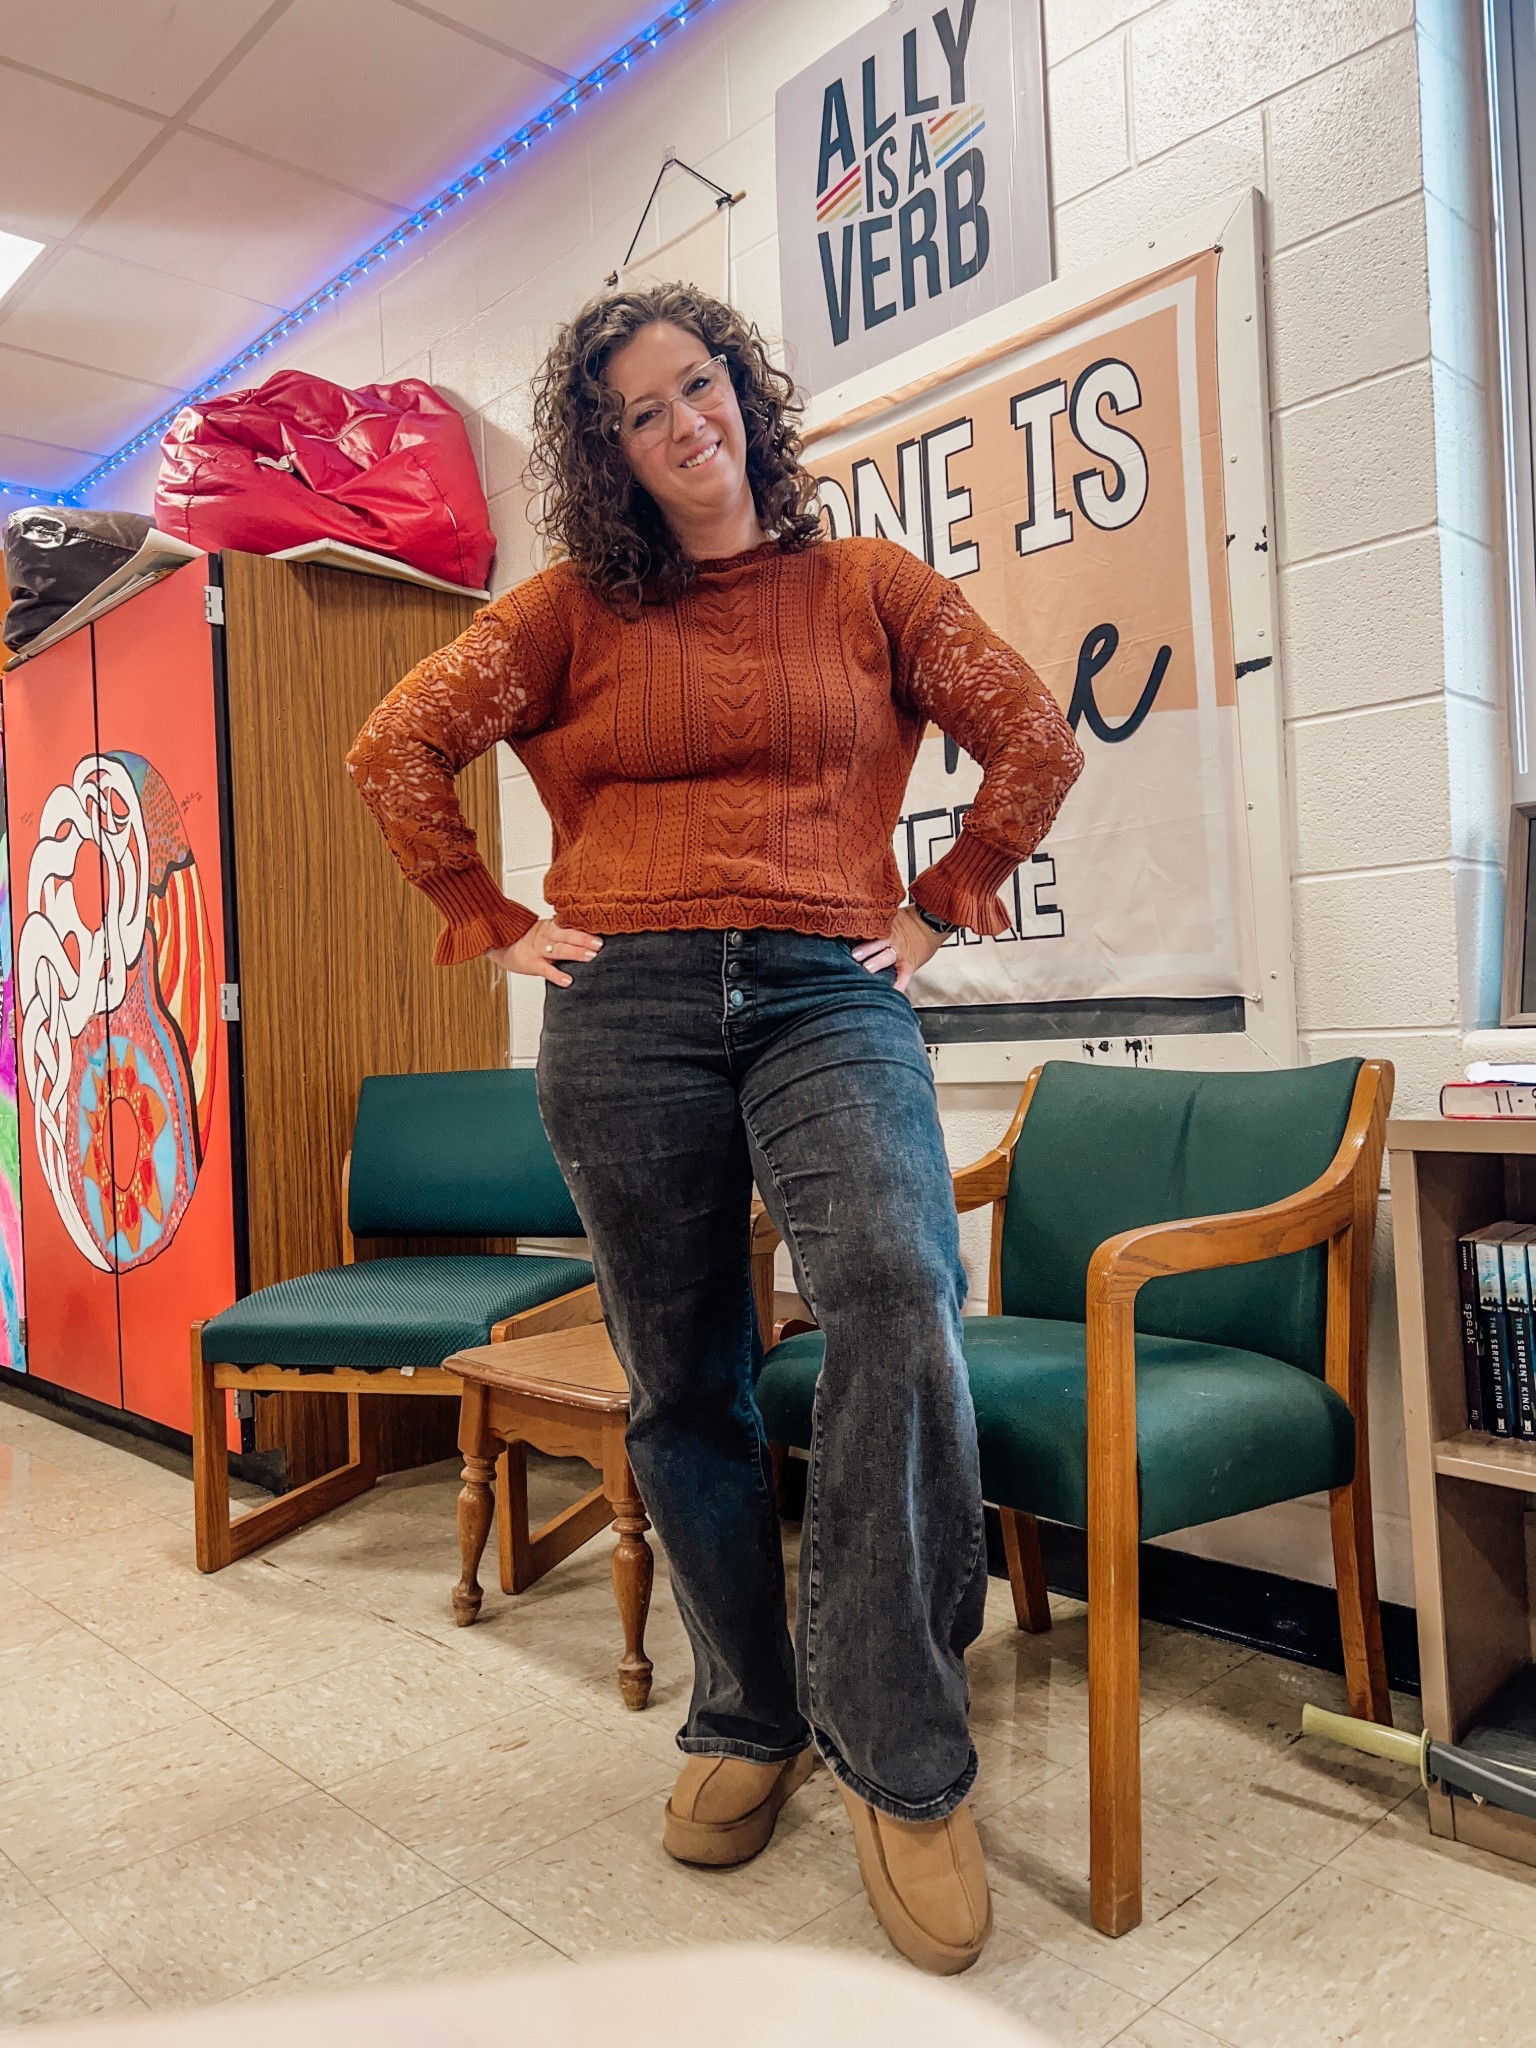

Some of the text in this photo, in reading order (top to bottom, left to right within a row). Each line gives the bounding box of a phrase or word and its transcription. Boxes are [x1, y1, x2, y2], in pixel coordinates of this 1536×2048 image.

[816, 0, 977, 198] ALLY
[866, 122, 932, 213] IS A
[817, 147, 990, 348] VERB
[1010, 357, 1150, 557] IS
[1463, 1303, 1476, 1344] speak
[1489, 1317, 1504, 1409] THE SERPENT KING
[1515, 1317, 1530, 1411] THE SERPENT KING
